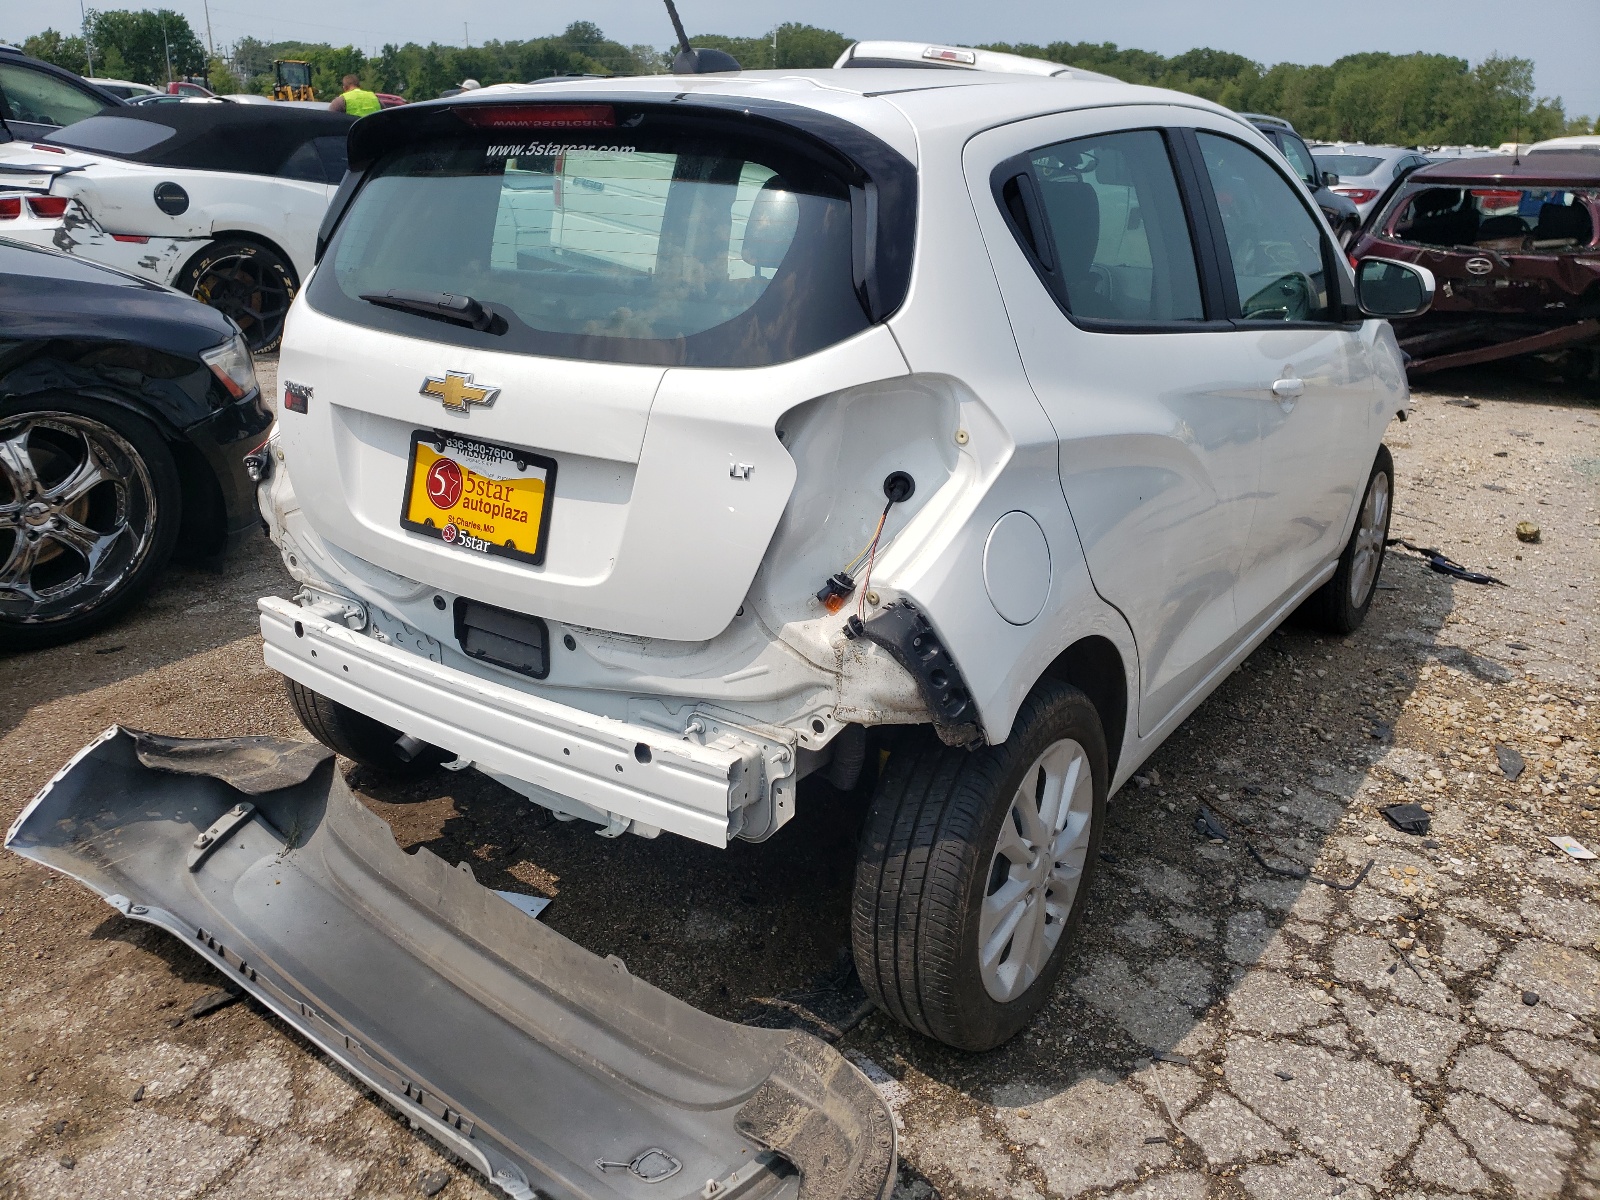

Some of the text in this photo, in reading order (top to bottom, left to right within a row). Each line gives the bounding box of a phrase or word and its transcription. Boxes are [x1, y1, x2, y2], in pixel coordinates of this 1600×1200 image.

[486, 141, 636, 158] www.5starcar.com
[446, 438, 514, 461] 636-940-7600
[729, 462, 755, 481] LT
[465, 470, 514, 503] 5star
[462, 496, 529, 524] autoplaza
[457, 530, 491, 553] 5star
